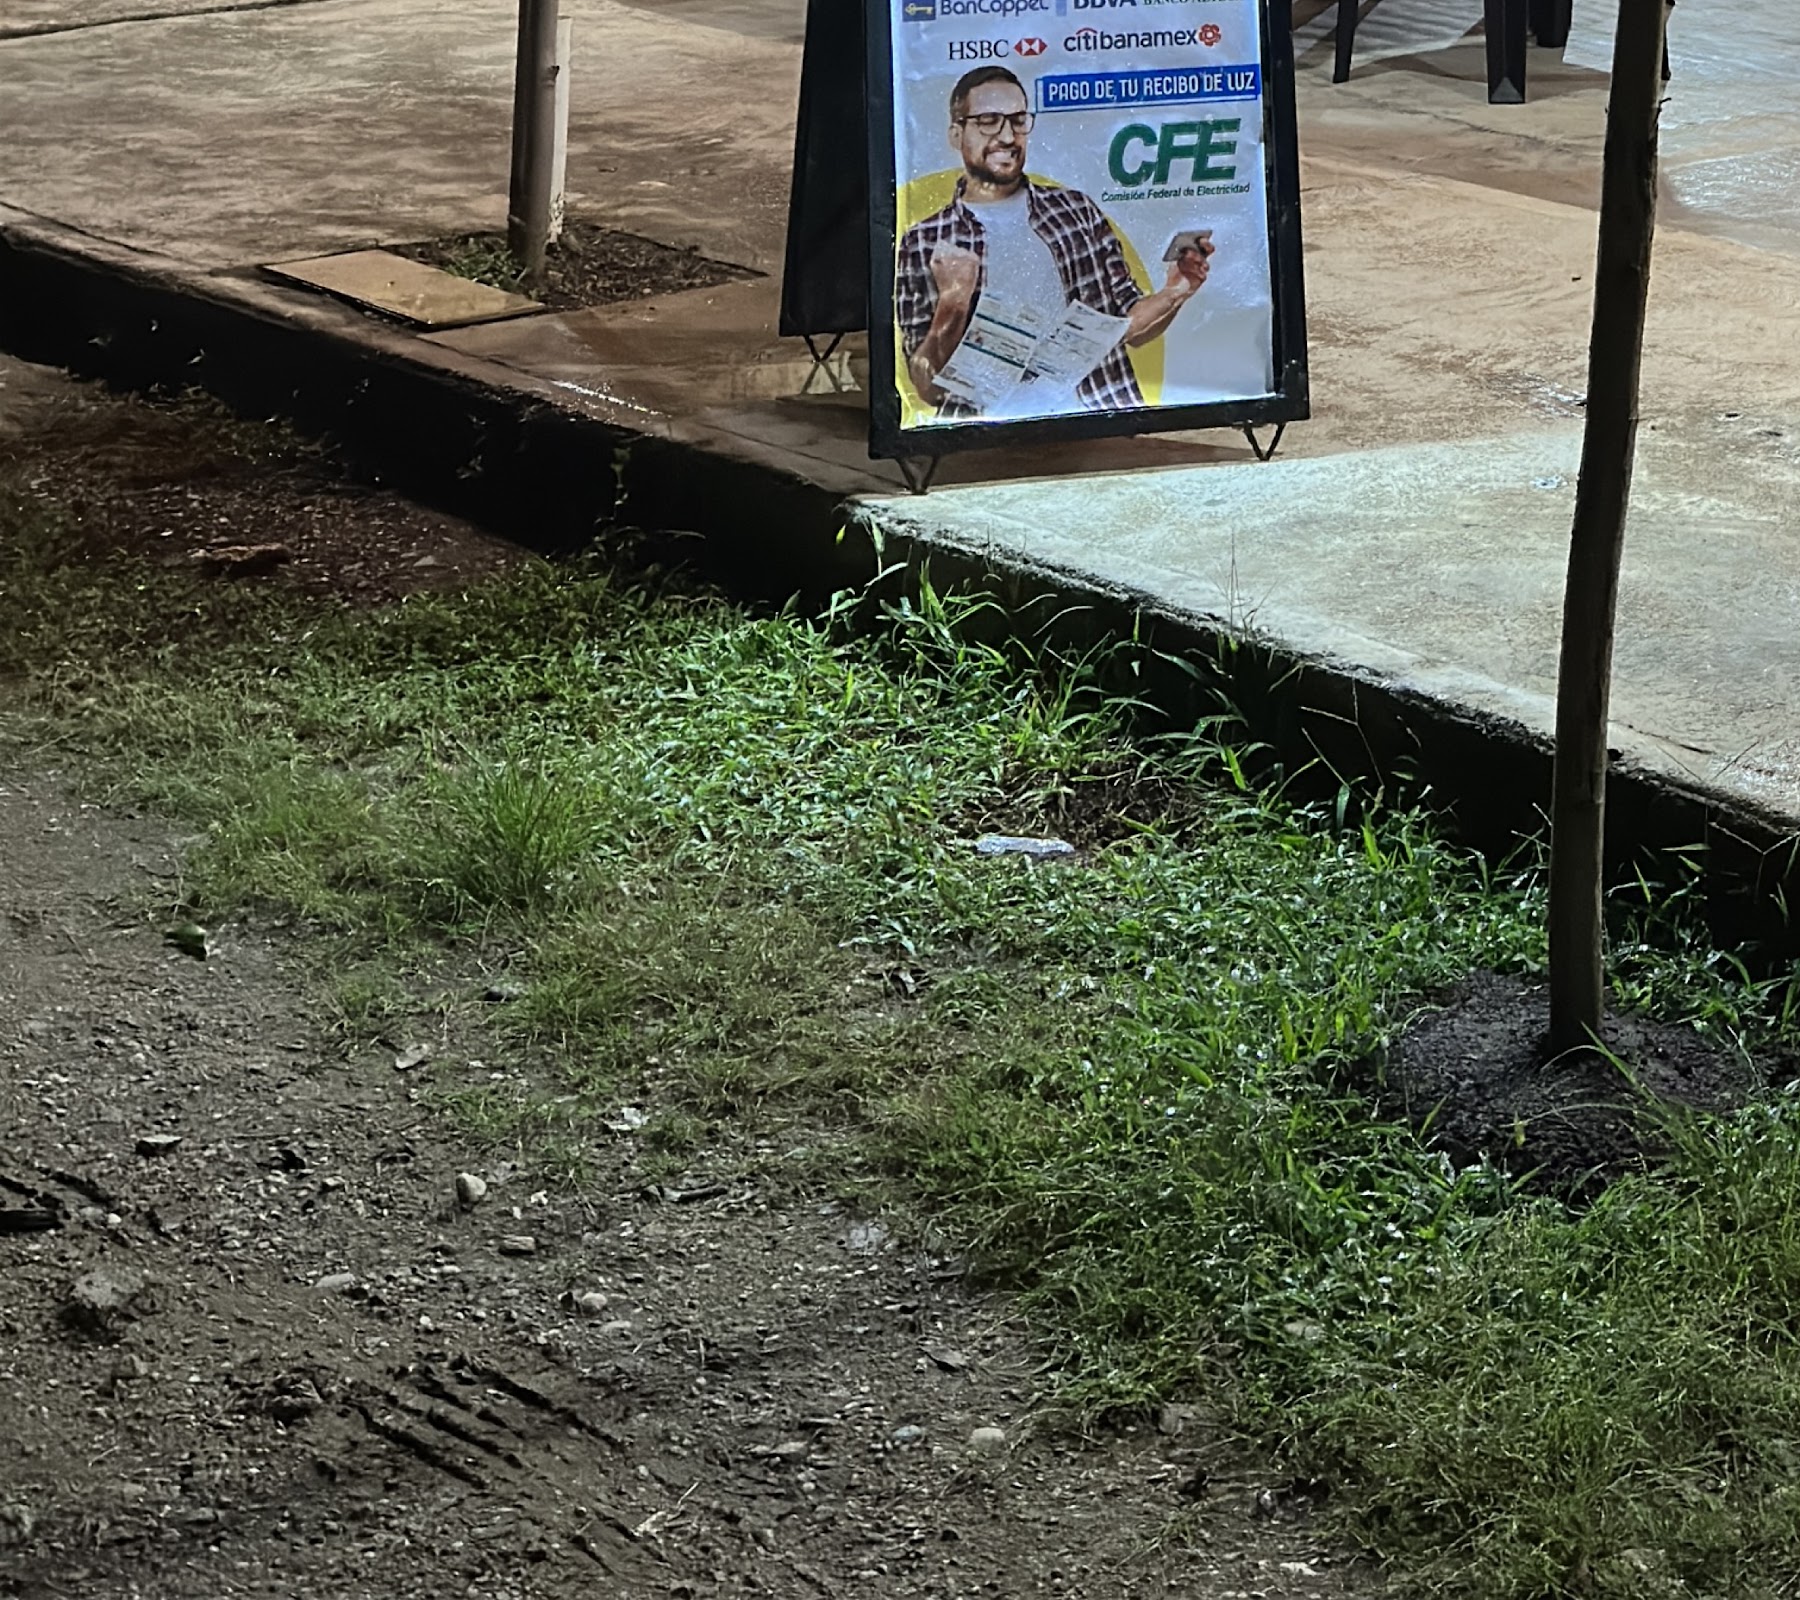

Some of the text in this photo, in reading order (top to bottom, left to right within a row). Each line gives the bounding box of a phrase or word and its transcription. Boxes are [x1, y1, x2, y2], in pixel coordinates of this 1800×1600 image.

[949, 40, 1009, 60] HSBC
[1063, 27, 1198, 52] citibanamex
[1050, 71, 1256, 101] PAGO DE TU RECIBO DE LUZ
[1107, 118, 1241, 188] CFE
[1101, 183, 1250, 202] Comisión Federal de Electricidad
